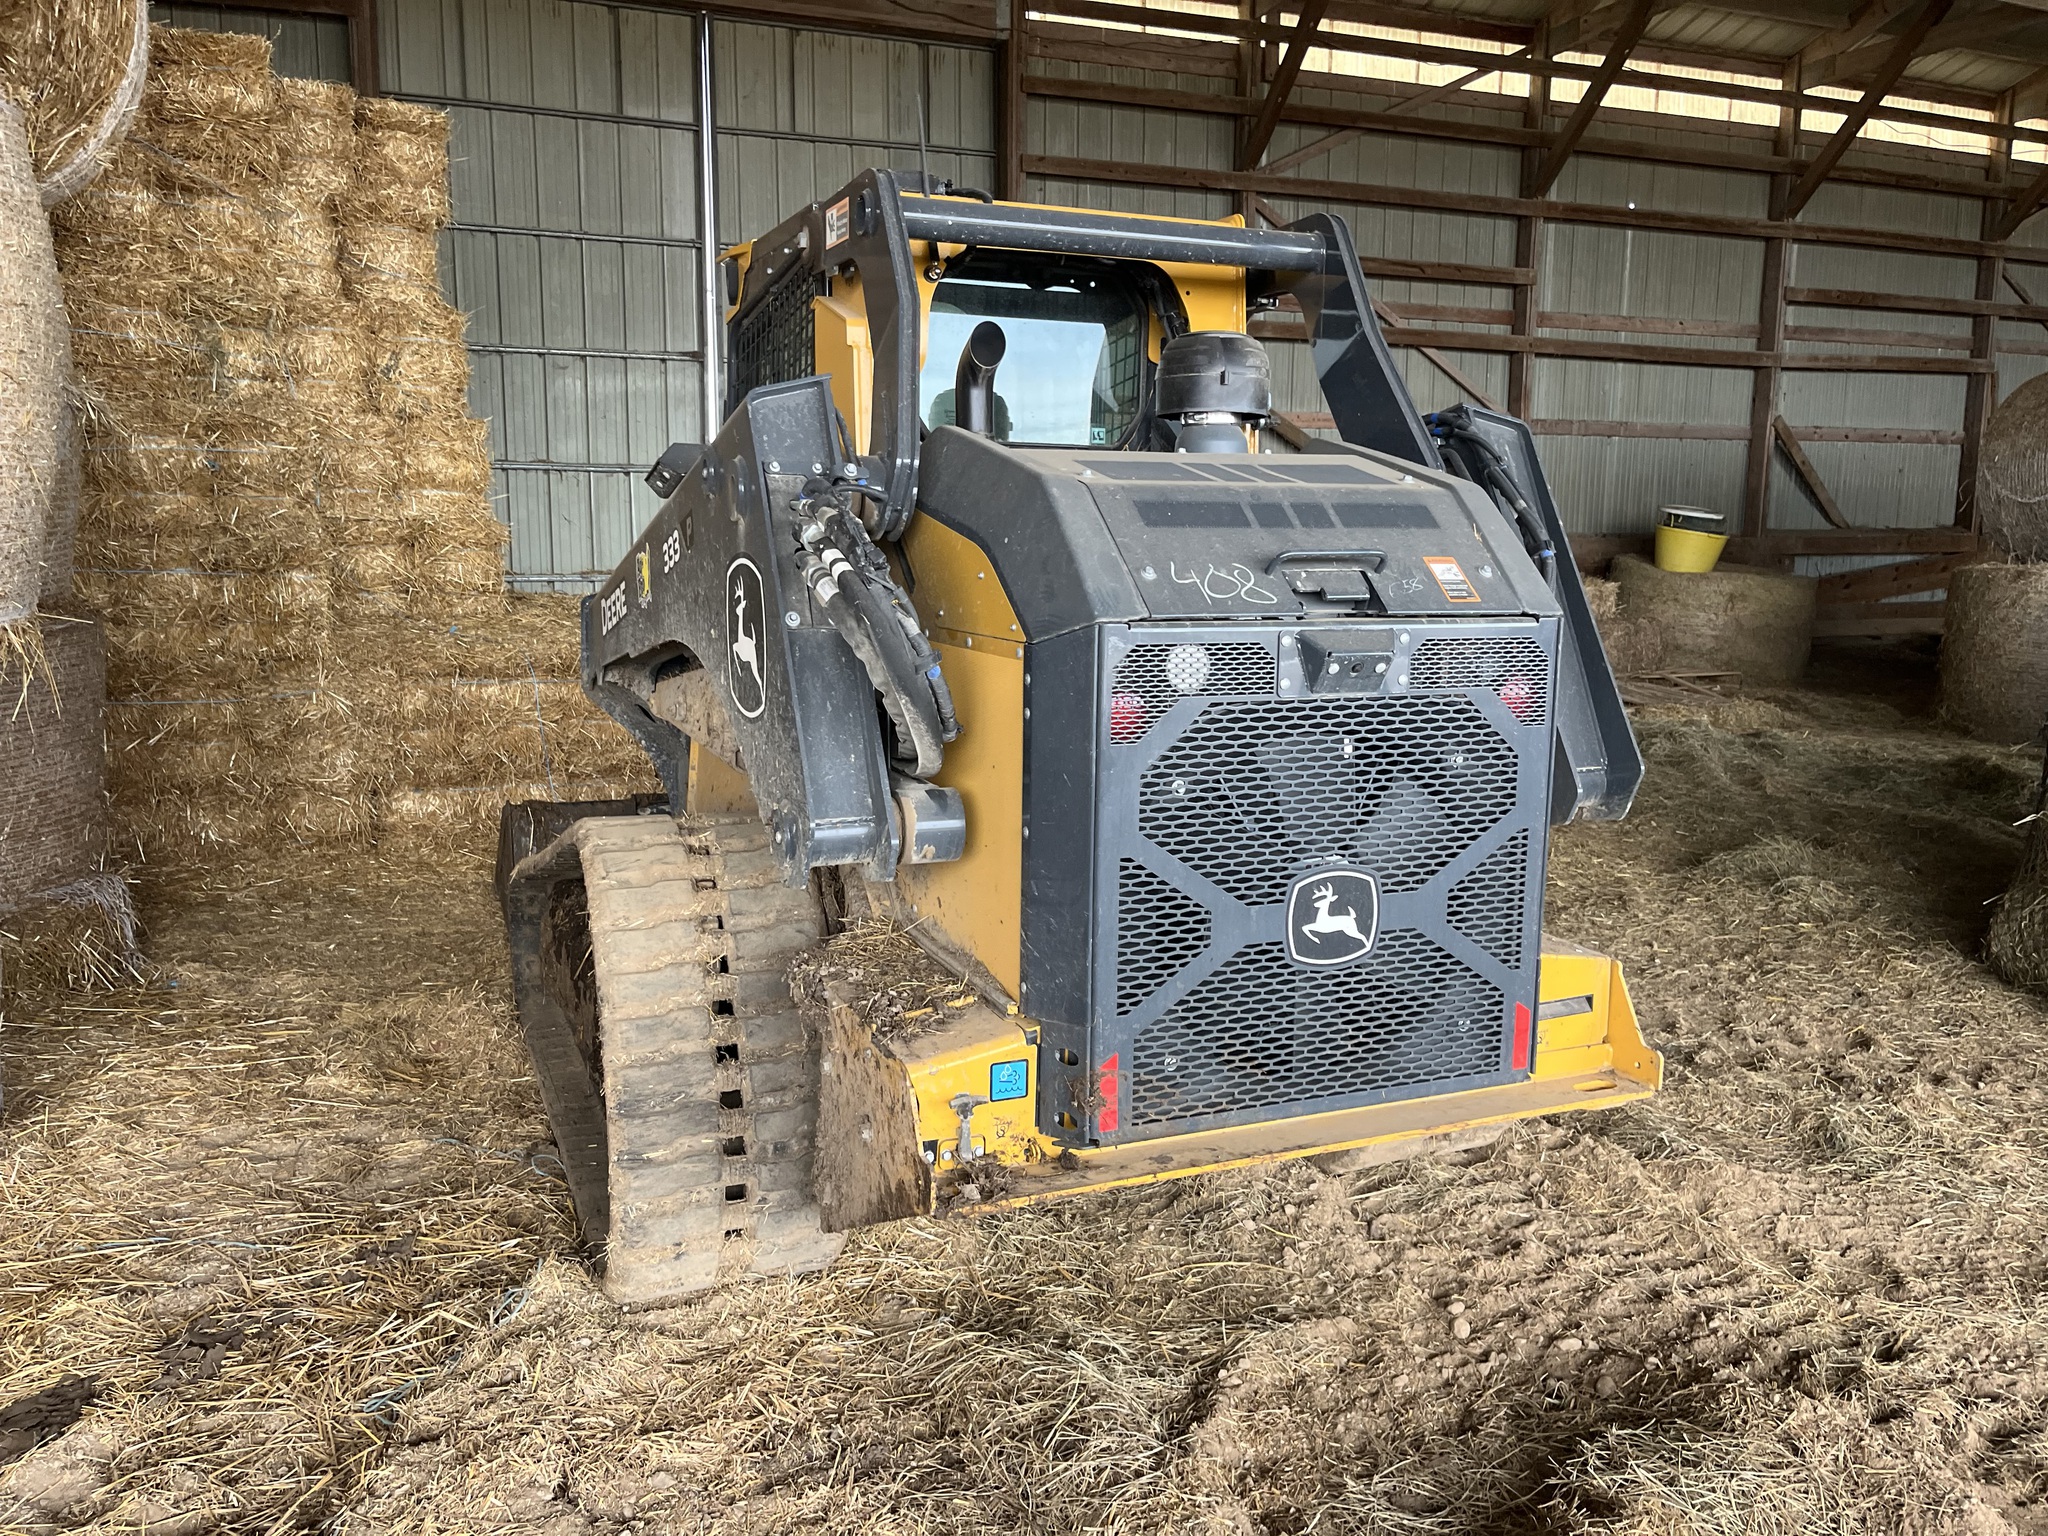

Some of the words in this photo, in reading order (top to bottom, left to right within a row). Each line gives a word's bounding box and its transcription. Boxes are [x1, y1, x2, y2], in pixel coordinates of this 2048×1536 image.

[663, 529, 681, 574] 333
[1171, 561, 1278, 606] 408
[601, 581, 627, 636] DEERE
